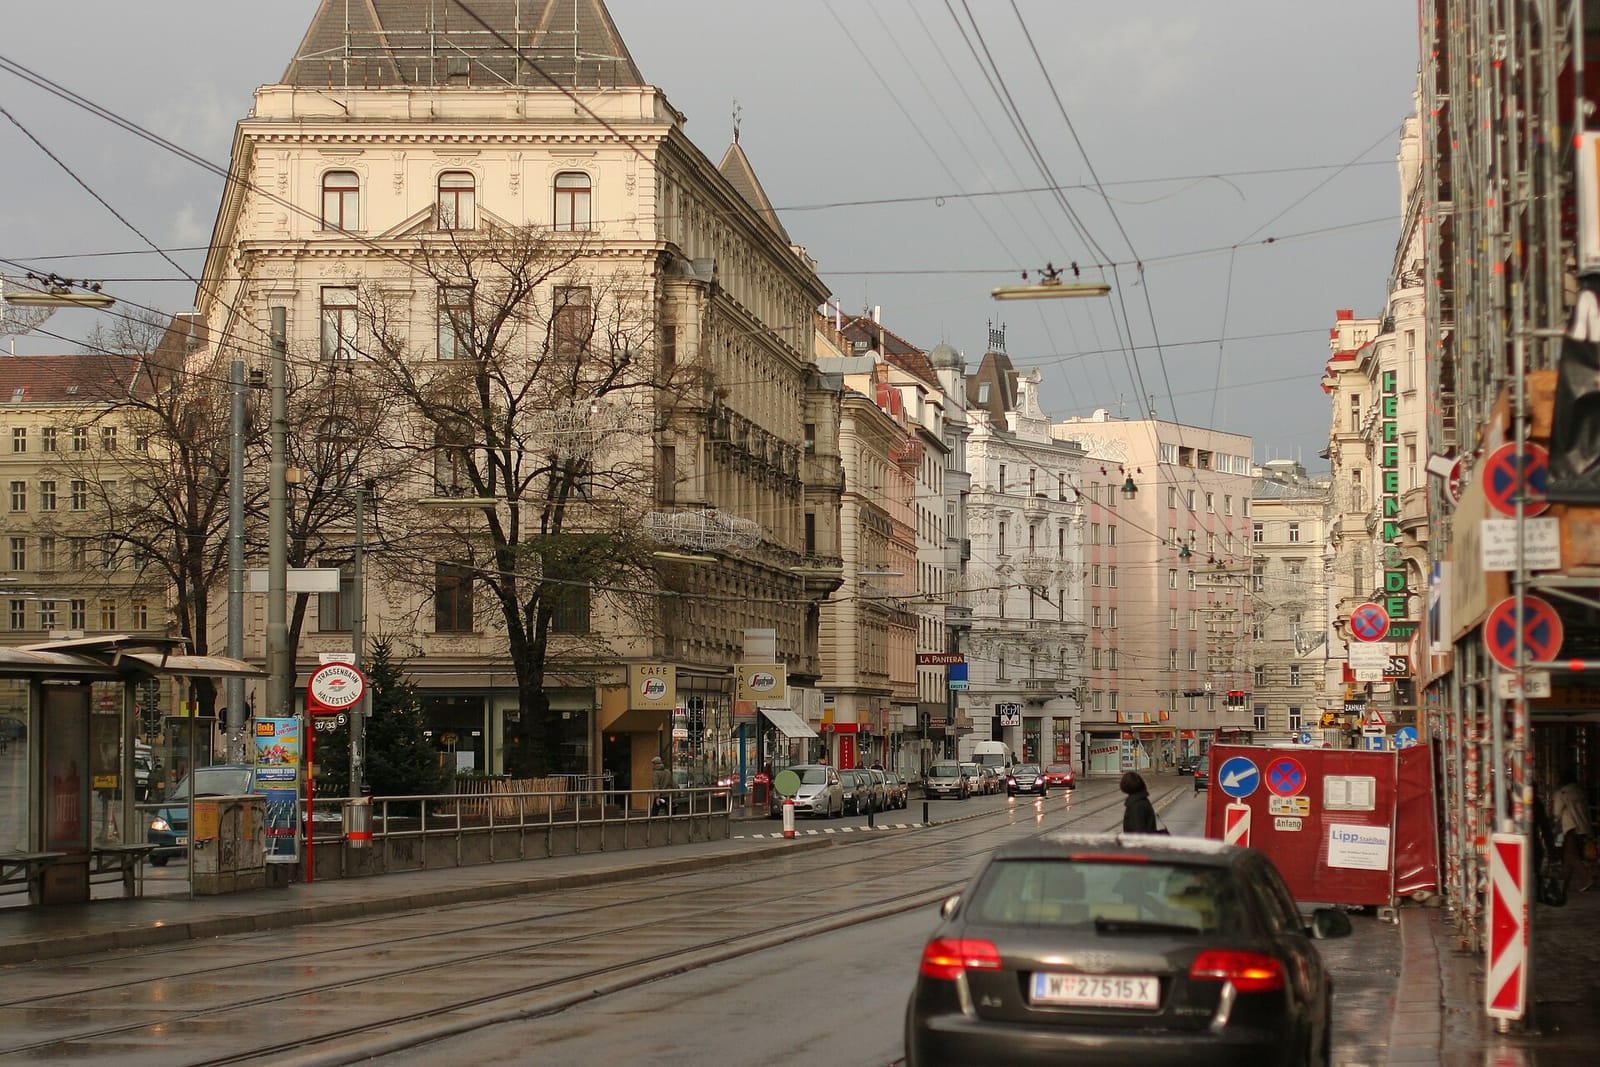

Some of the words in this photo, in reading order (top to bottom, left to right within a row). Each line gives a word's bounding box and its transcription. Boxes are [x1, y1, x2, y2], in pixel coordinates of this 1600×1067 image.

[920, 655, 930, 663] LA
[932, 655, 963, 663] PANTERA
[316, 668, 360, 684] STRASSENBAHN
[640, 667, 668, 675] CAFE
[1507, 679, 1541, 694] Ede
[318, 690, 358, 704] HALTESTELLE
[1276, 818, 1301, 830] Anfang
[1332, 830, 1359, 844] Lipp
[1050, 977, 1063, 996] W
[1078, 978, 1134, 999] 27515
[1139, 981, 1150, 1001] X
